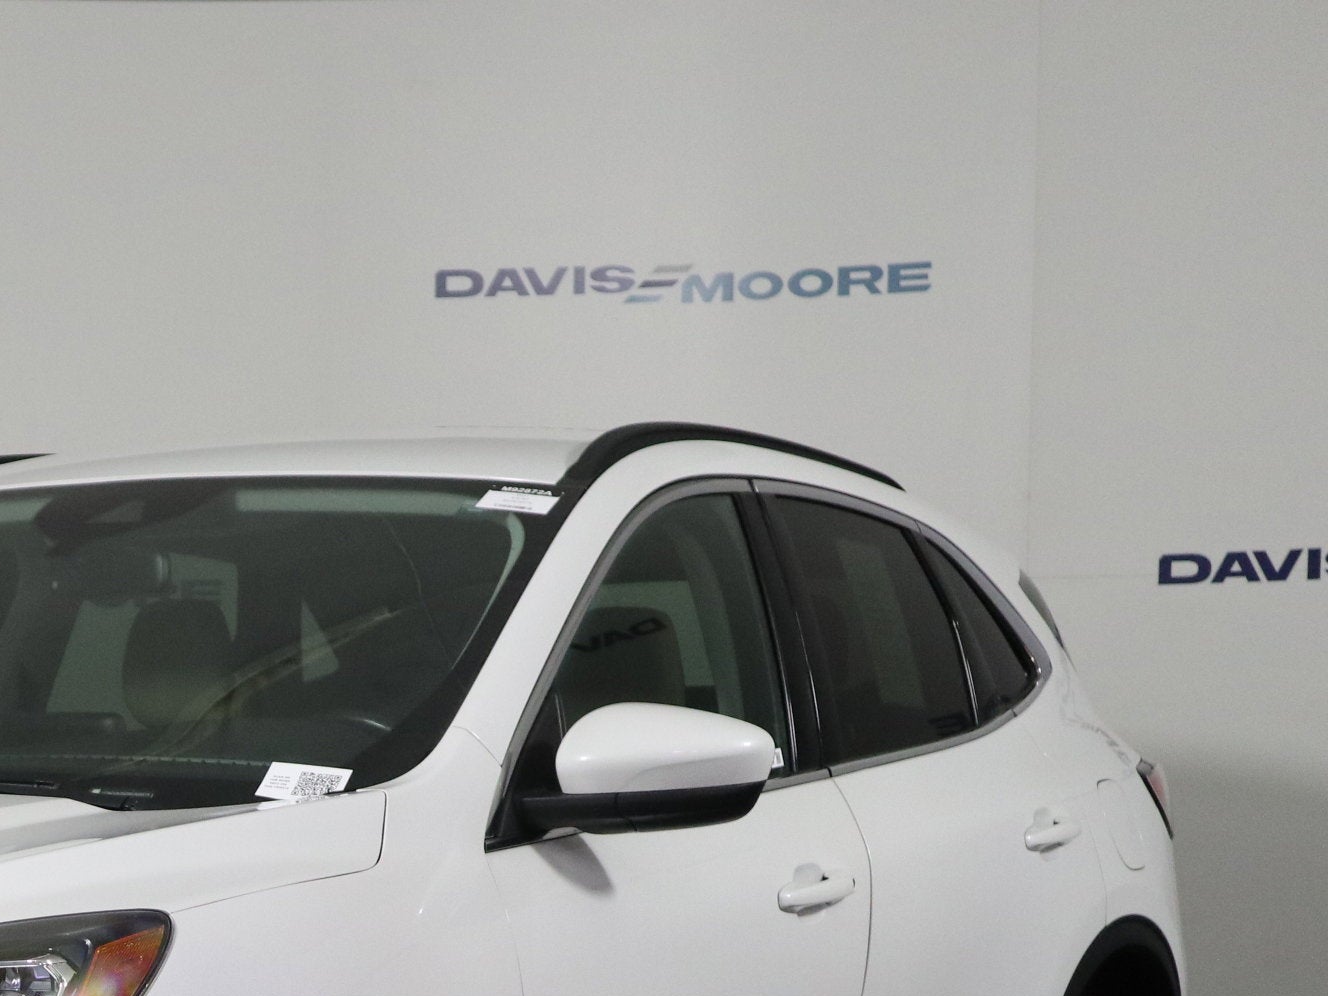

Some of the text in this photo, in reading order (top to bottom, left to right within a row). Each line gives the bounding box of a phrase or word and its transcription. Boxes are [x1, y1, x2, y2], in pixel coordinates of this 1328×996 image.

[434, 261, 932, 303] DAVIS MOORE
[1158, 548, 1328, 585] DAVI
